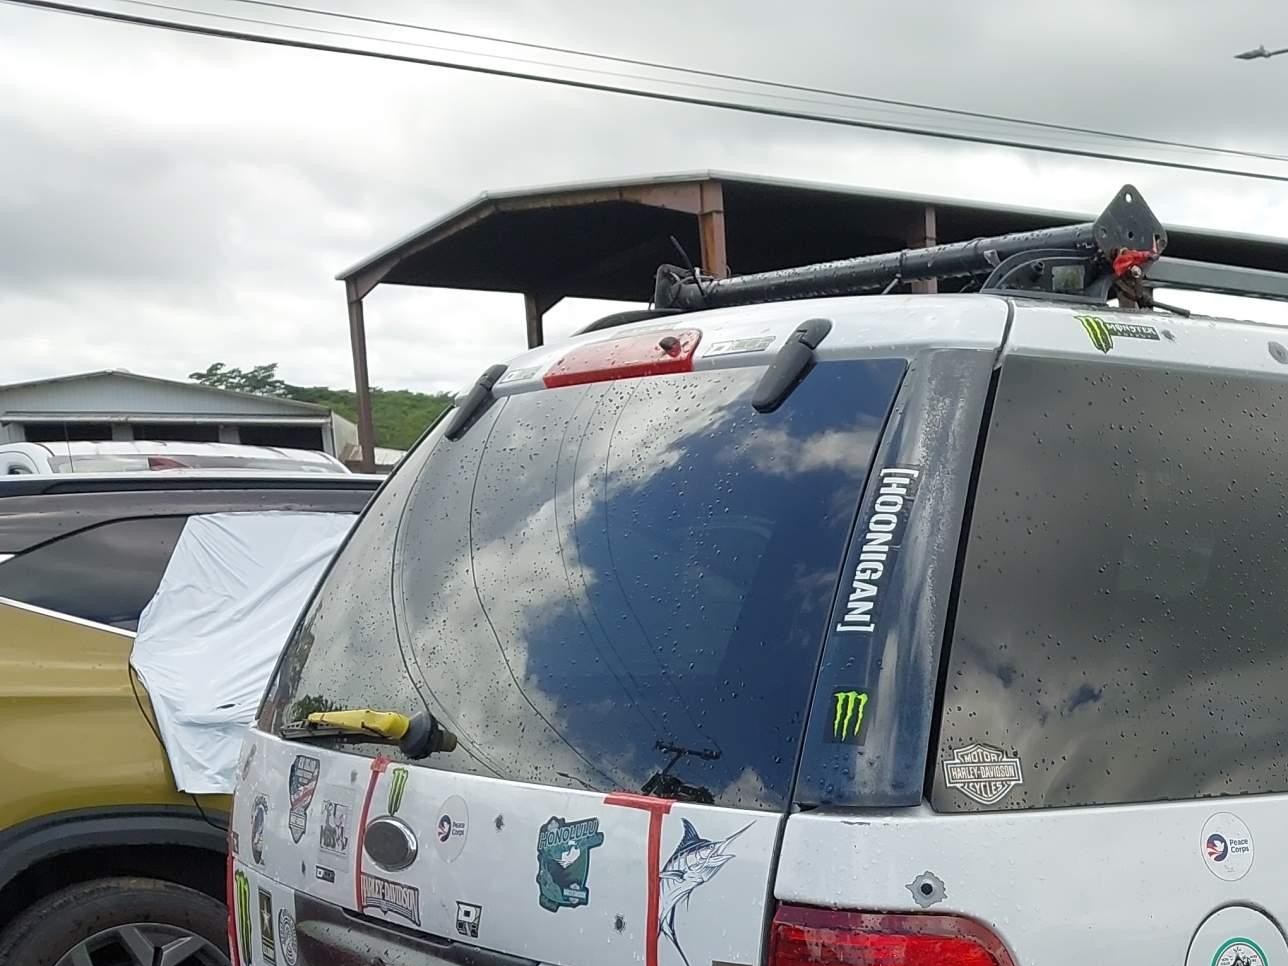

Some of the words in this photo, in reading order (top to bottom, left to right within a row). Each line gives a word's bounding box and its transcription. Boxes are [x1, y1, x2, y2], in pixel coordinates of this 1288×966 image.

[963, 748, 998, 763] MOTOR
[951, 765, 1015, 780] HARLEY-DAVIDSON
[968, 781, 1003, 797] CYCLES
[539, 820, 598, 850] HONOLULU
[1229, 838, 1249, 847] Peace
[1230, 846, 1250, 855] Corps
